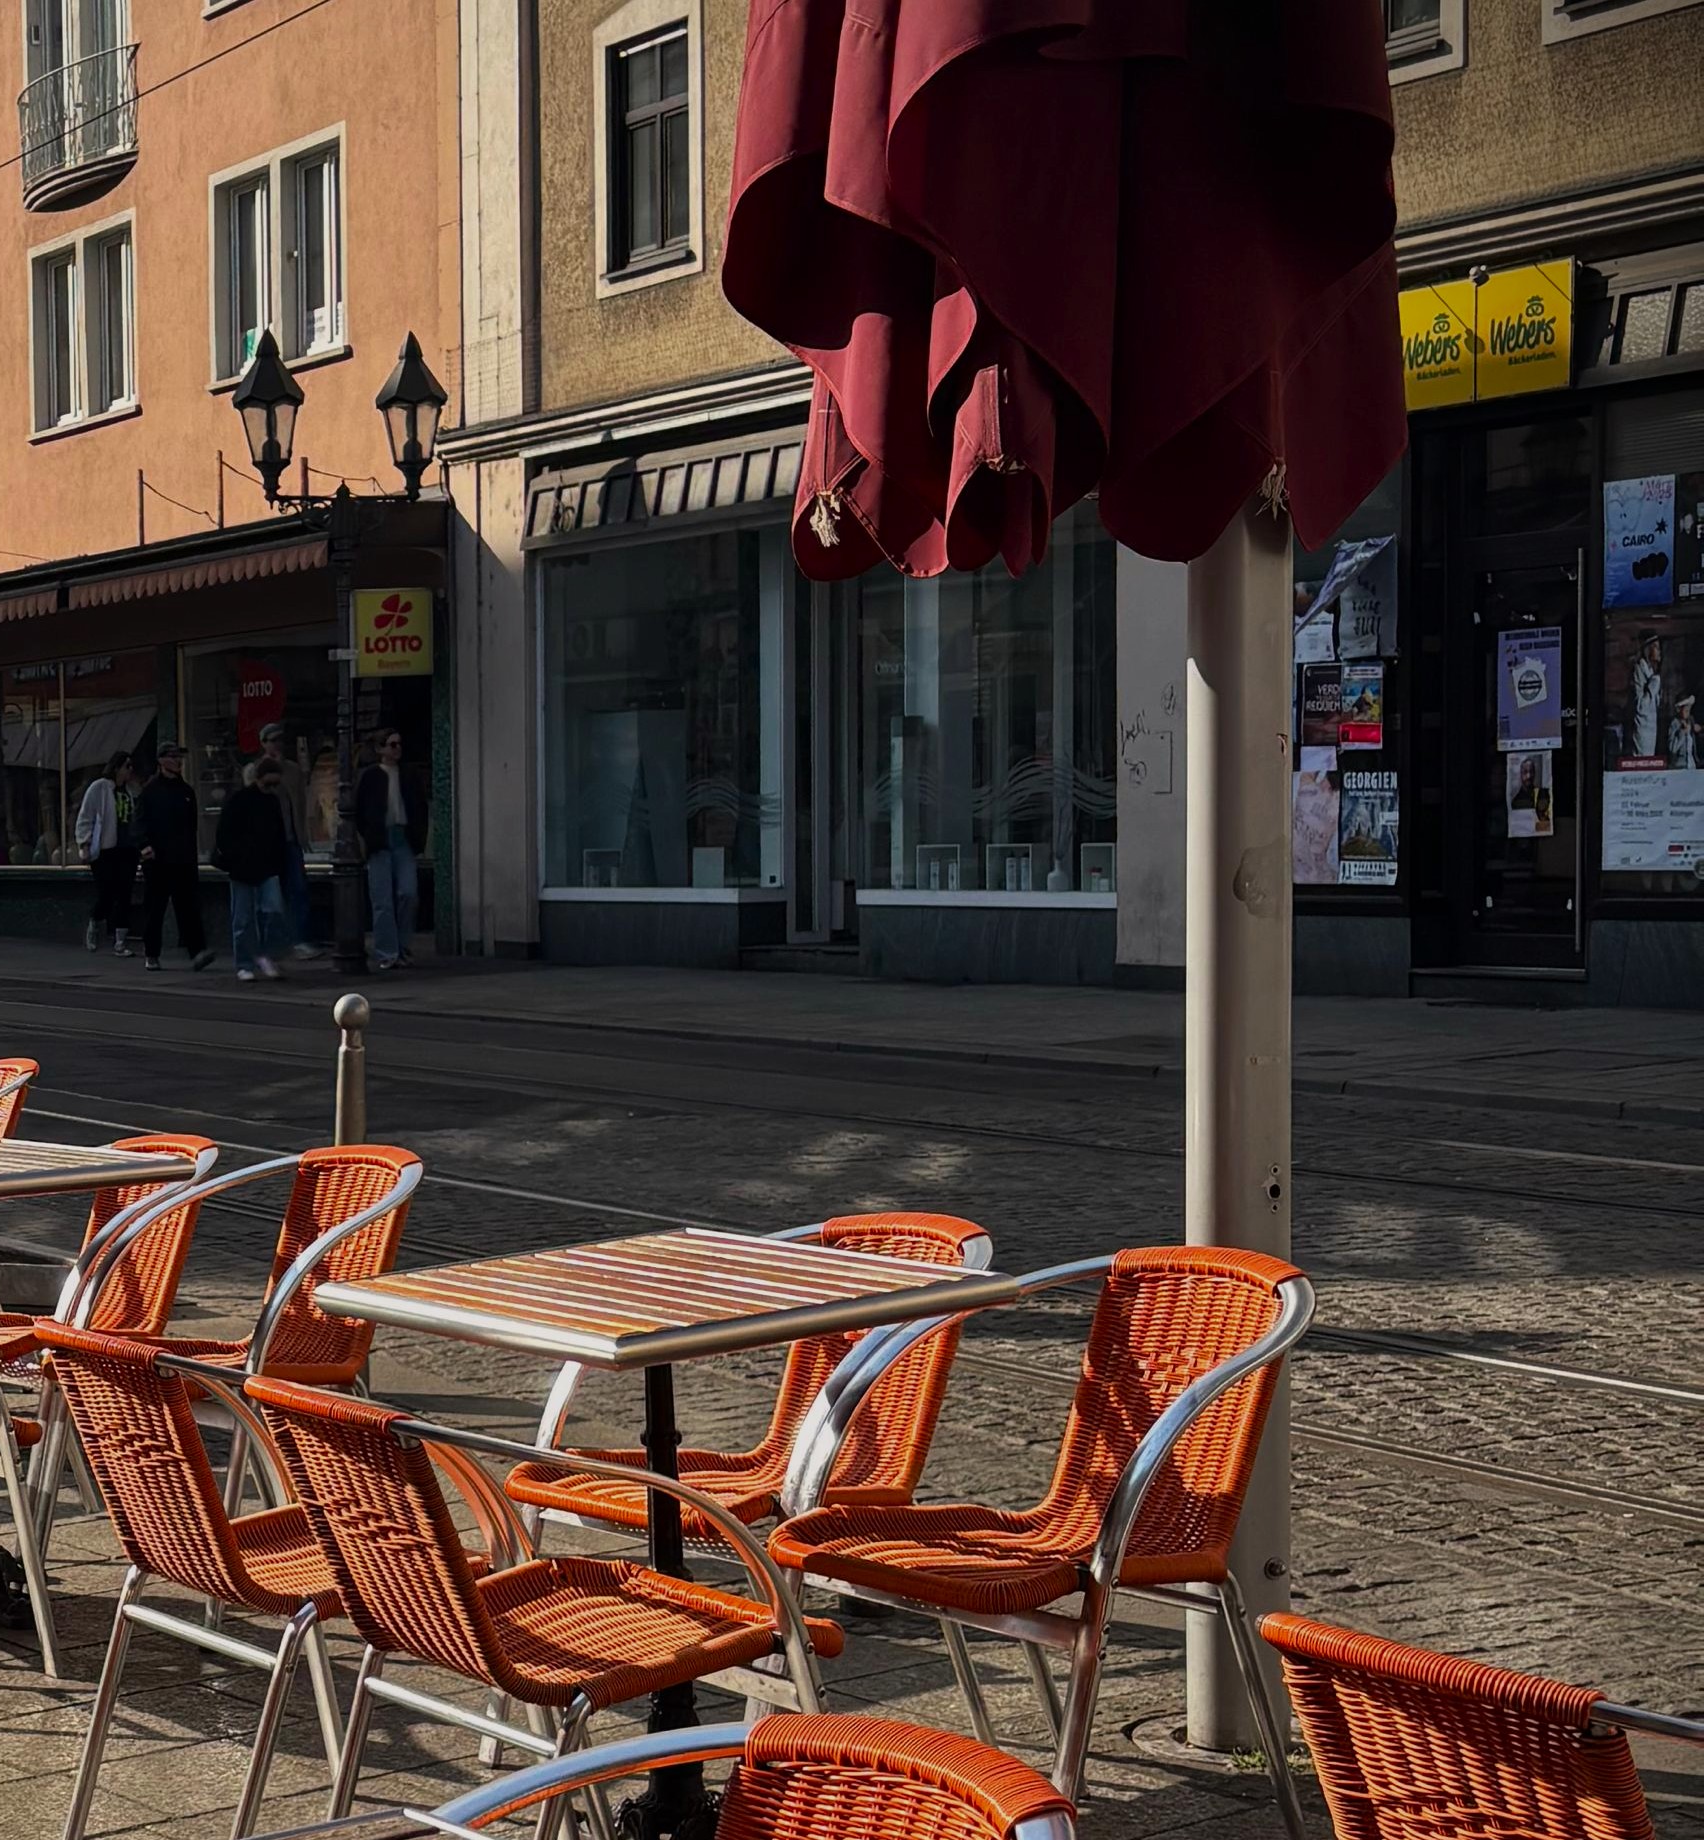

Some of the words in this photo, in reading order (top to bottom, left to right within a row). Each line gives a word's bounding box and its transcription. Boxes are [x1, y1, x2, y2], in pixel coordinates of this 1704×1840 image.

[1490, 313, 1556, 356] Webers
[1622, 533, 1655, 547] CAIRO
[365, 635, 422, 653] LOTTO
[242, 680, 273, 698] LOTTO
[1343, 771, 1398, 790] GEORGIEN
